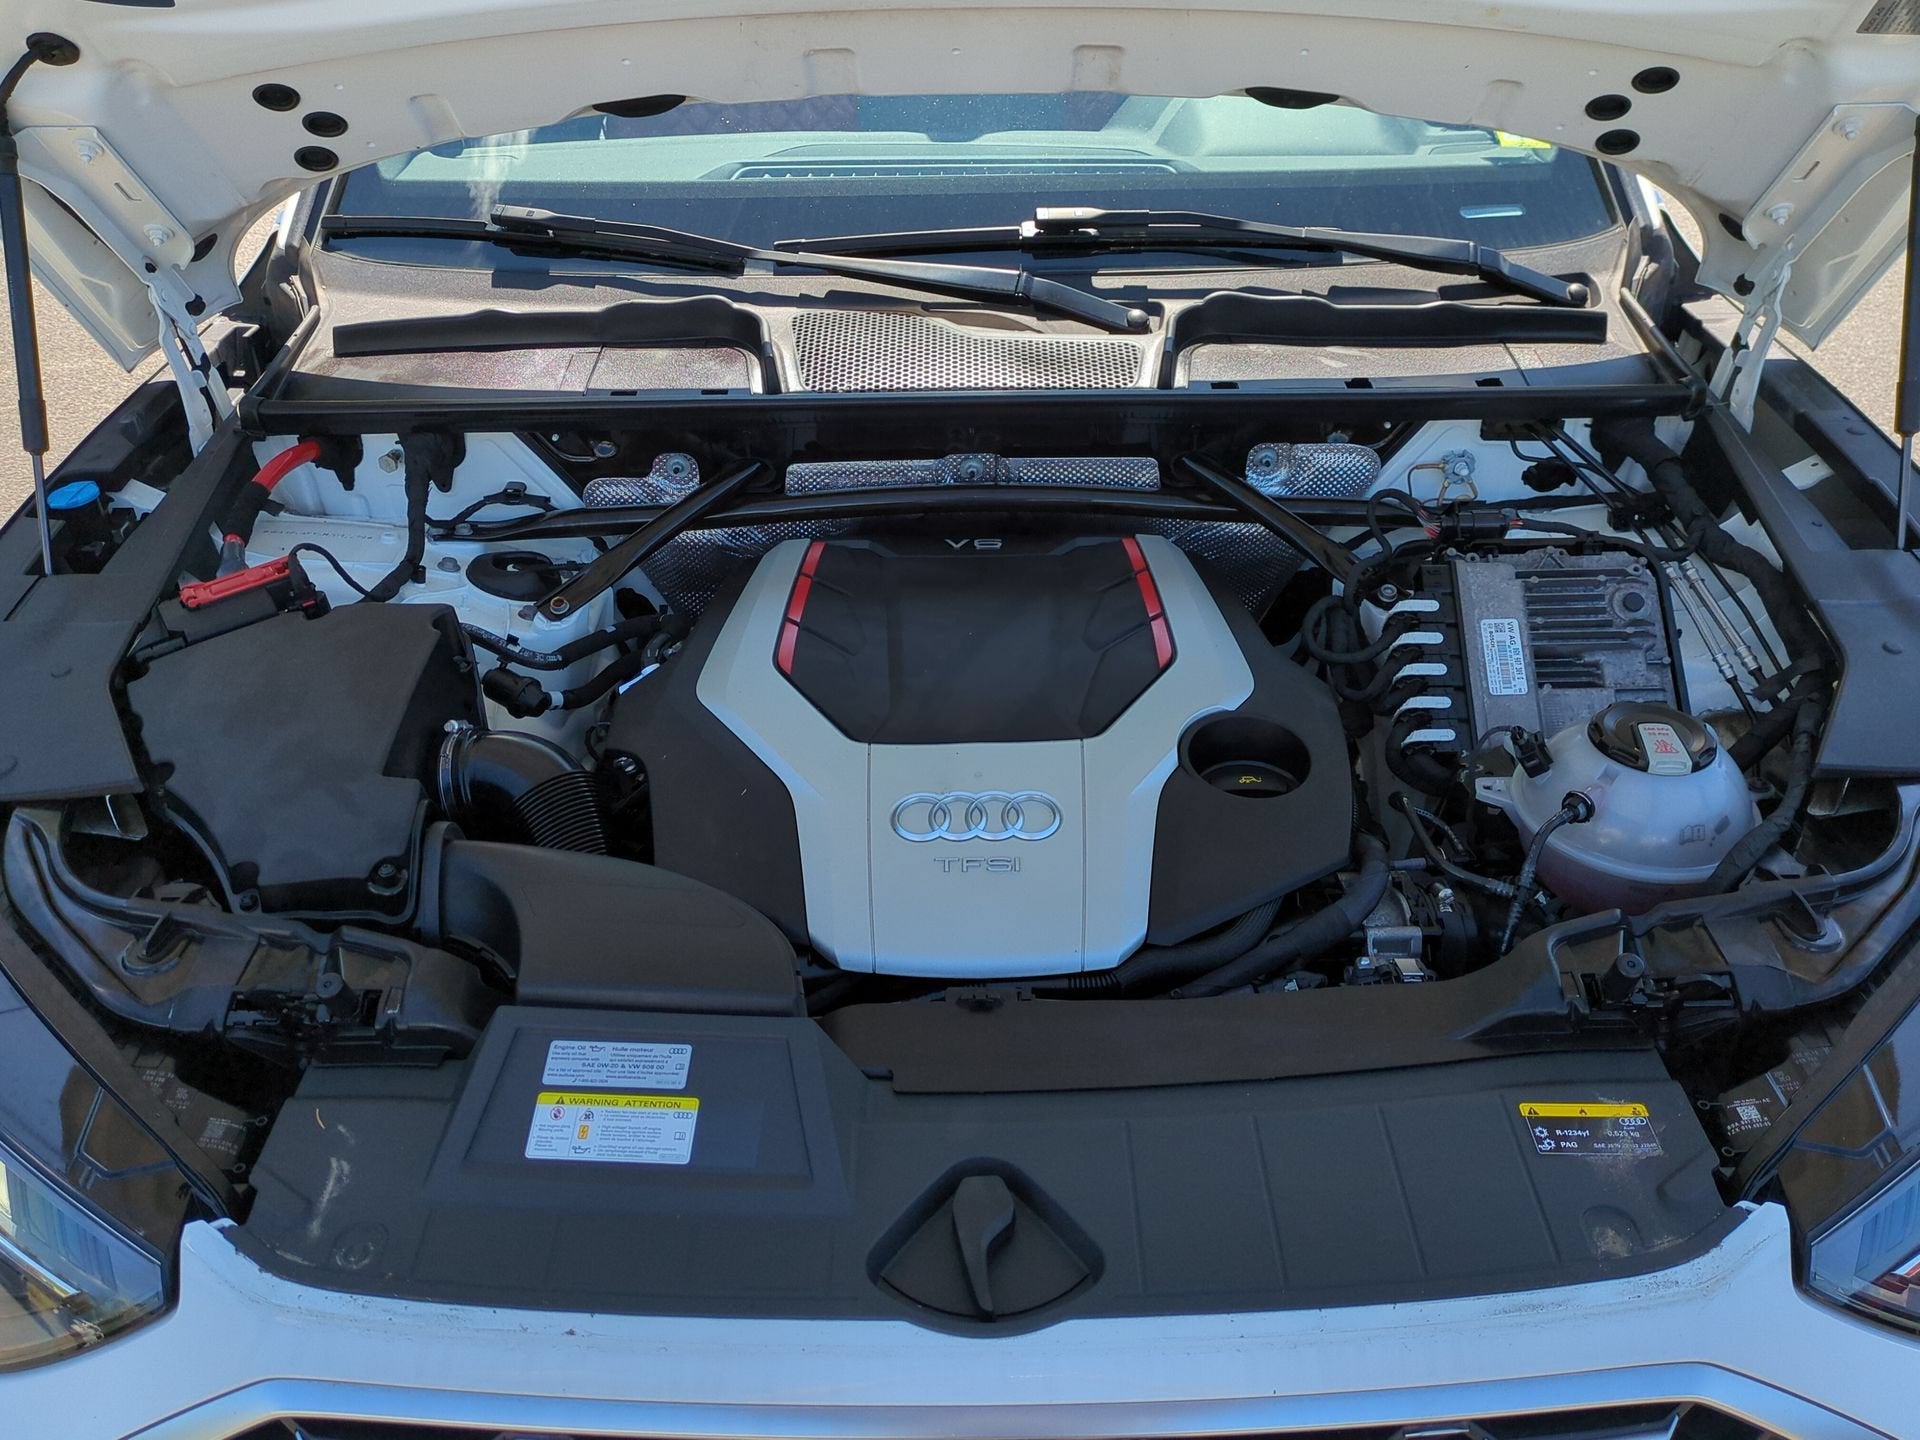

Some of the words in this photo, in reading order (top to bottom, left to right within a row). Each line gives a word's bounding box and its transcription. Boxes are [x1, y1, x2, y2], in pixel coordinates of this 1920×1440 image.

[944, 539, 1002, 549] V6
[1507, 621, 1514, 633] VW
[1509, 634, 1517, 646] AG
[934, 856, 1021, 873] TFSI
[569, 1098, 619, 1106] WARNING
[624, 1100, 682, 1108] ATTENTION
[1555, 1129, 1590, 1137] R-1234yf
[1629, 1130, 1640, 1138] kg
